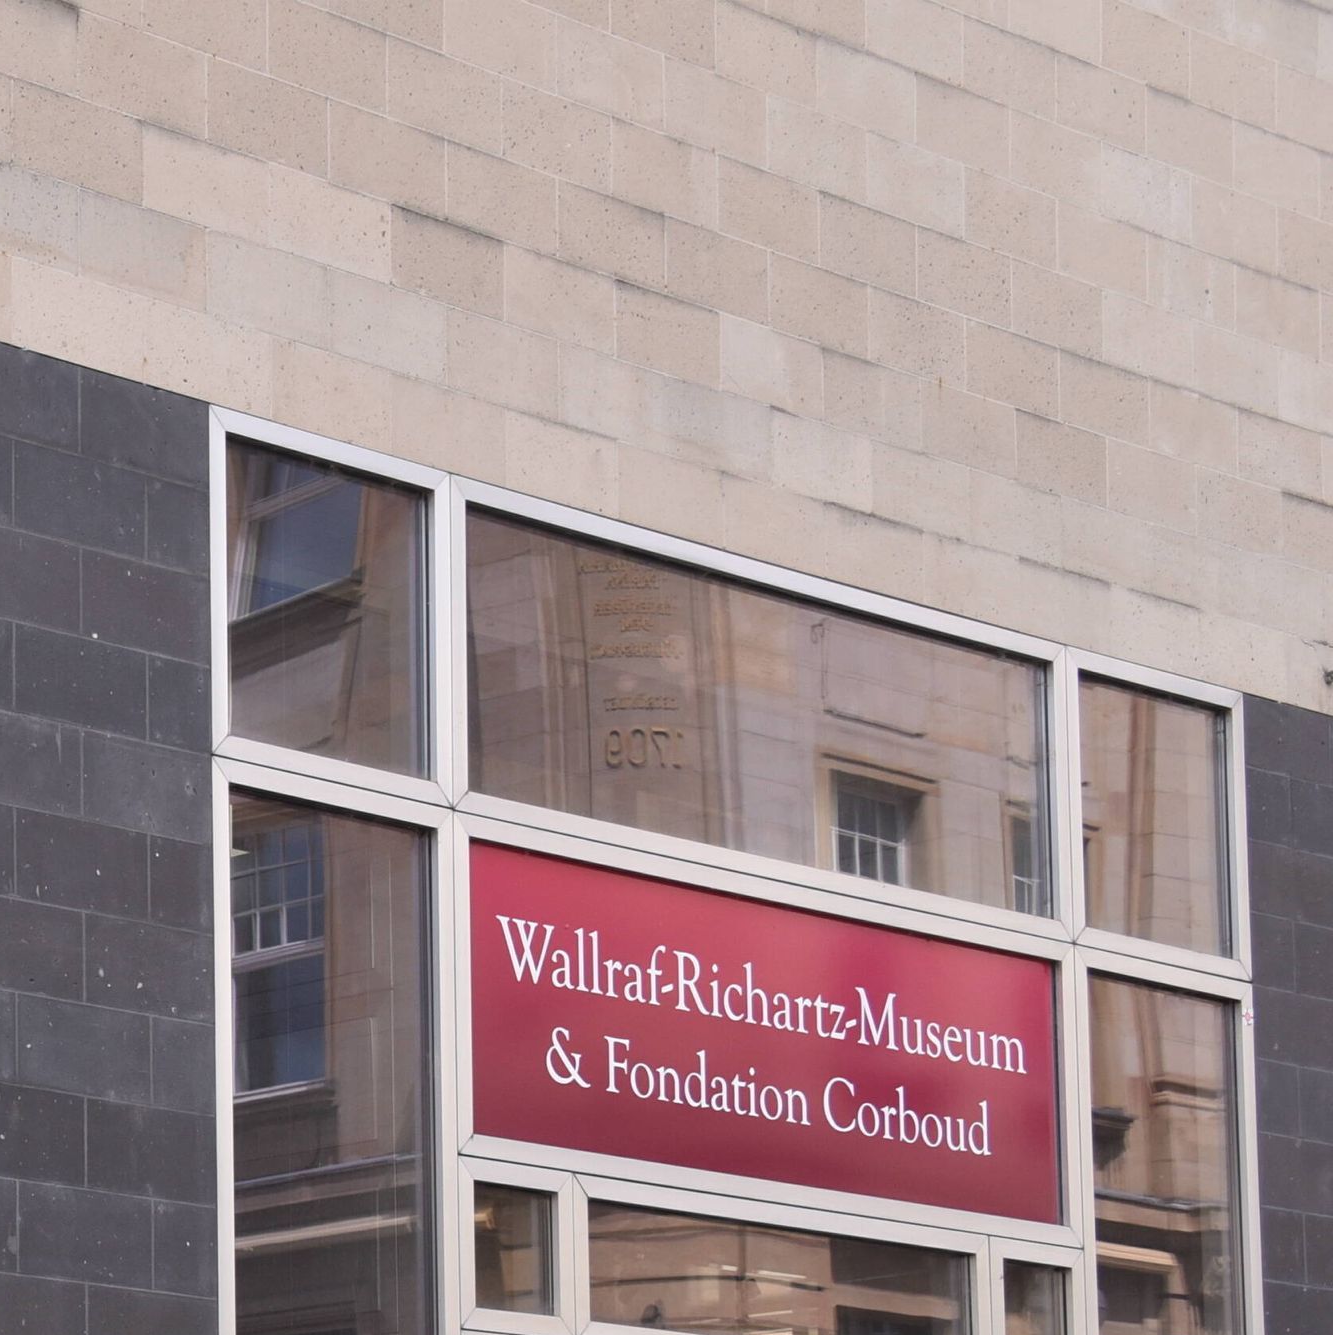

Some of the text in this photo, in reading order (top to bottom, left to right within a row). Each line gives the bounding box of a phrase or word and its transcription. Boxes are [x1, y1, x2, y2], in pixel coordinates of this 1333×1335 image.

[495, 914, 1027, 1074] Wallraf-Richartz-Museum
[546, 1026, 992, 1156] & Fondation Corboud
